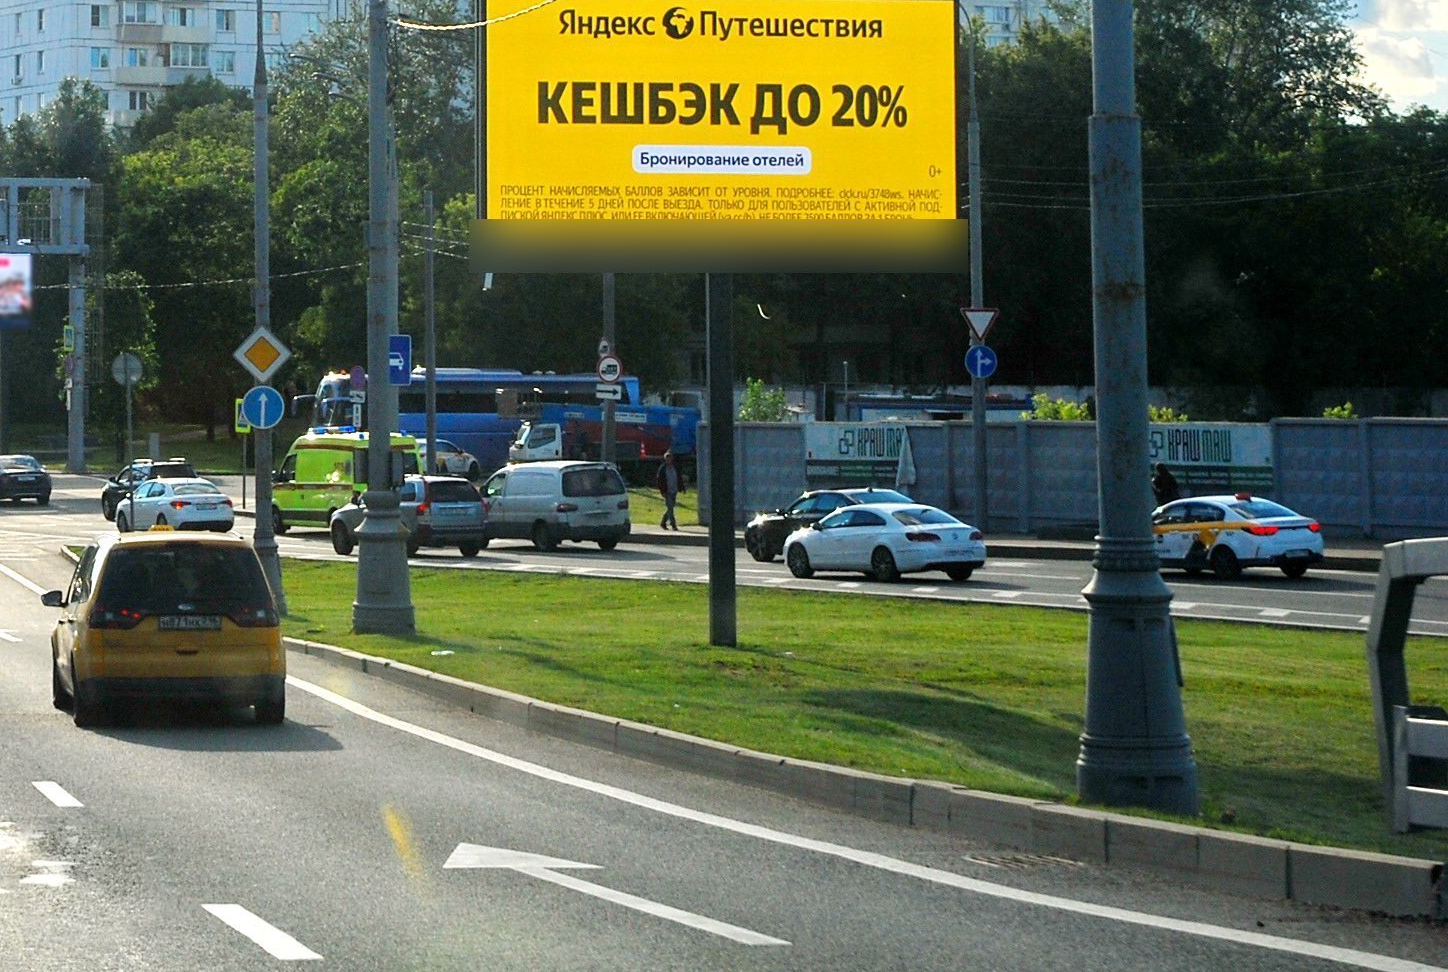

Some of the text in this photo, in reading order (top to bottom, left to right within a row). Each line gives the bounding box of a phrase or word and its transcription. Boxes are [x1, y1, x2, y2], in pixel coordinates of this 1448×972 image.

[558, 9, 883, 41] Яндекс Путешествия
[537, 81, 908, 135] КЕШБЭК ДО 20%
[640, 151, 804, 169] Бронирование отелей
[500, 185, 544, 197] ПРОЦЕНТ
[549, 185, 621, 196] НАЧИСЛЯЕМЫХ
[625, 186, 663, 196] БАЛЛОВ
[667, 186, 710, 197] ЗАВИСИТ
[715, 186, 728, 197] ОТ
[501, 198, 531, 209] ЛЕНИЕ
[536, 198, 542, 208] В
[544, 198, 584, 209] ТЕЧЕНИЕ
[589, 199, 594, 209] 5
[598, 196, 624, 210] ДНЕЙ
[627, 199, 659, 209] ПОСЛЕ
[708, 199, 744, 210] ТОЛЬКО
[748, 200, 768, 211] ДЛЯ
[772, 198, 850, 211] ПОЛЬЗОВАТЕЛЕЙ
[854, 201, 861, 211] С
[865, 199, 915, 212] АКТИВНОЙ
